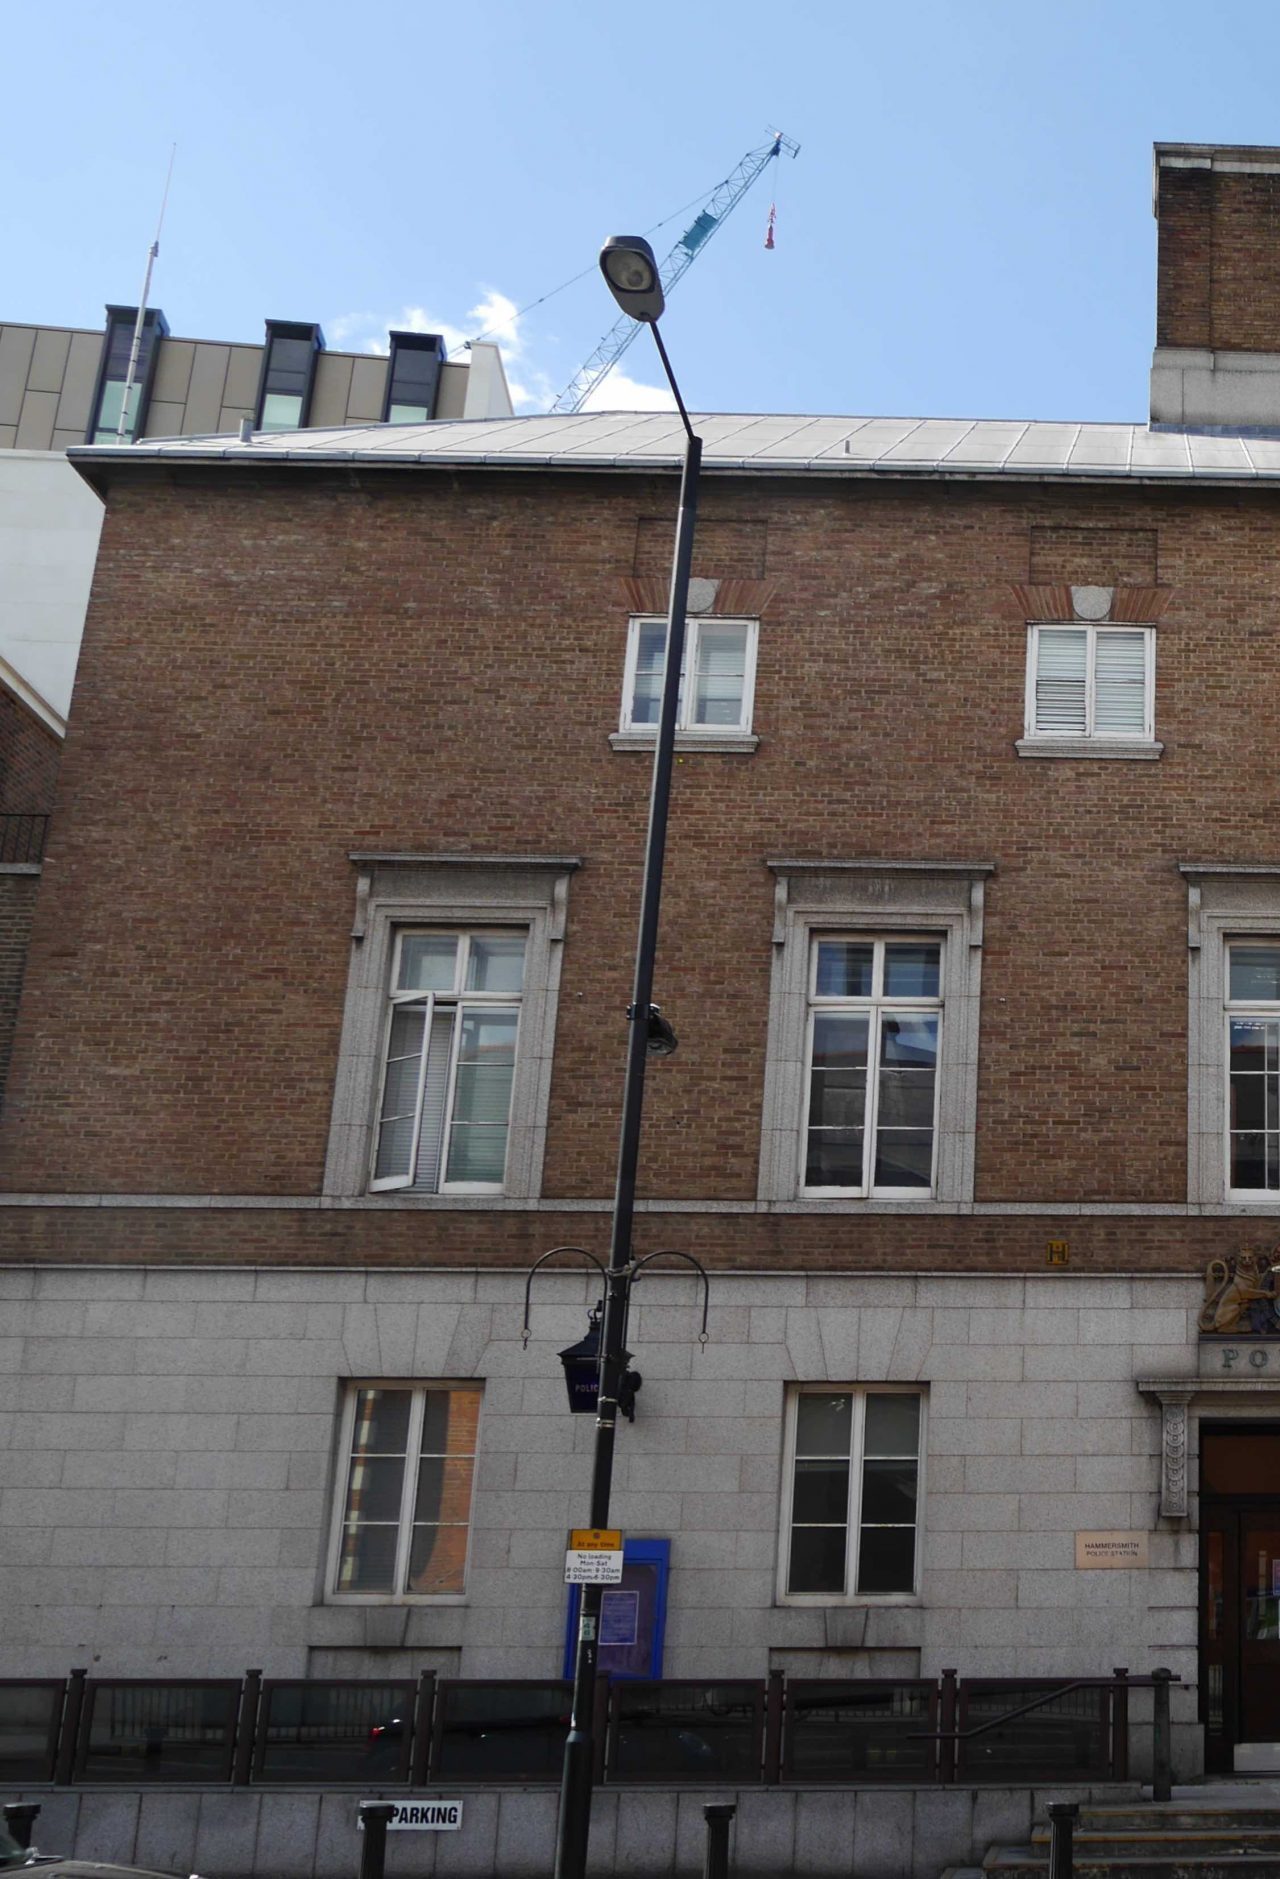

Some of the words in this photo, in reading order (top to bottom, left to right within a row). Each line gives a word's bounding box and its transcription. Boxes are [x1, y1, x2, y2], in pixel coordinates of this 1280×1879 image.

[575, 1384, 599, 1392] POLIC
[1084, 1542, 1139, 1550] HAMMERSMITH
[588, 1553, 612, 1561] loading
